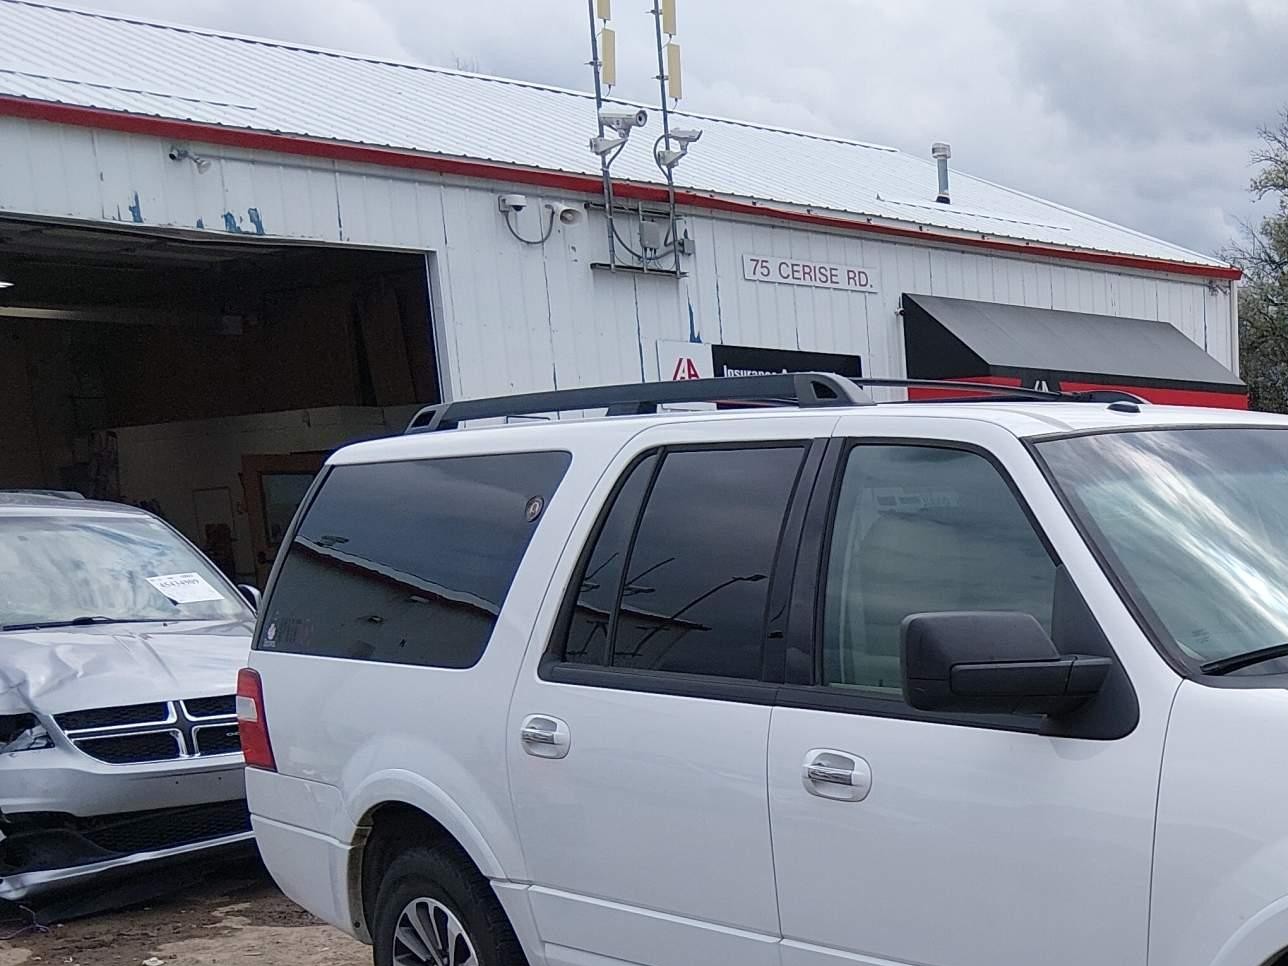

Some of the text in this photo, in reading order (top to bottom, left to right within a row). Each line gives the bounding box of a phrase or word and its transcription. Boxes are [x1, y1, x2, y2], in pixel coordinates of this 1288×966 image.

[750, 258, 873, 288] 75 CERISE RD.
